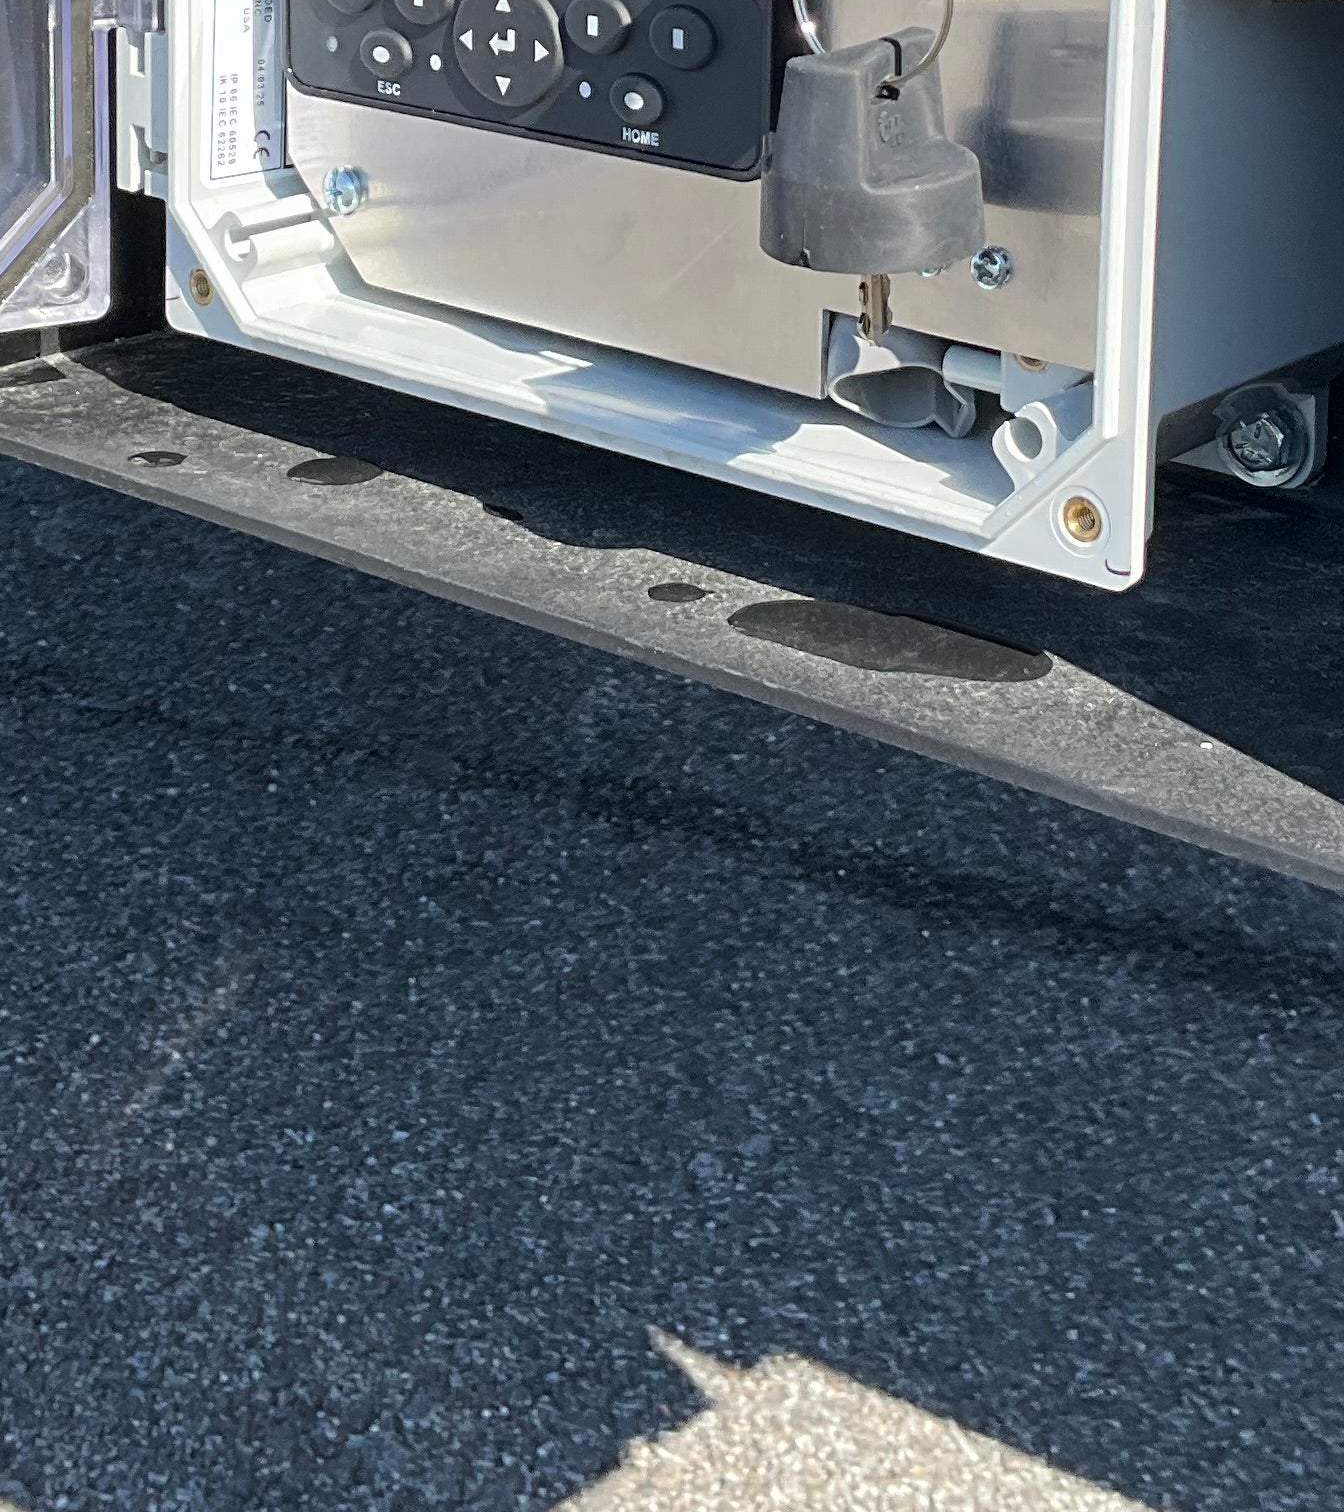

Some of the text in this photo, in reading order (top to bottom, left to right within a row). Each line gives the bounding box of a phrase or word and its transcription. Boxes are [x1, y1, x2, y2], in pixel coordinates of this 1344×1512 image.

[242, 7, 251, 33] USA
[377, 80, 401, 96] ESC
[218, 108, 227, 128] IEC
[229, 106, 238, 126] IEC
[622, 126, 660, 147] HOME
